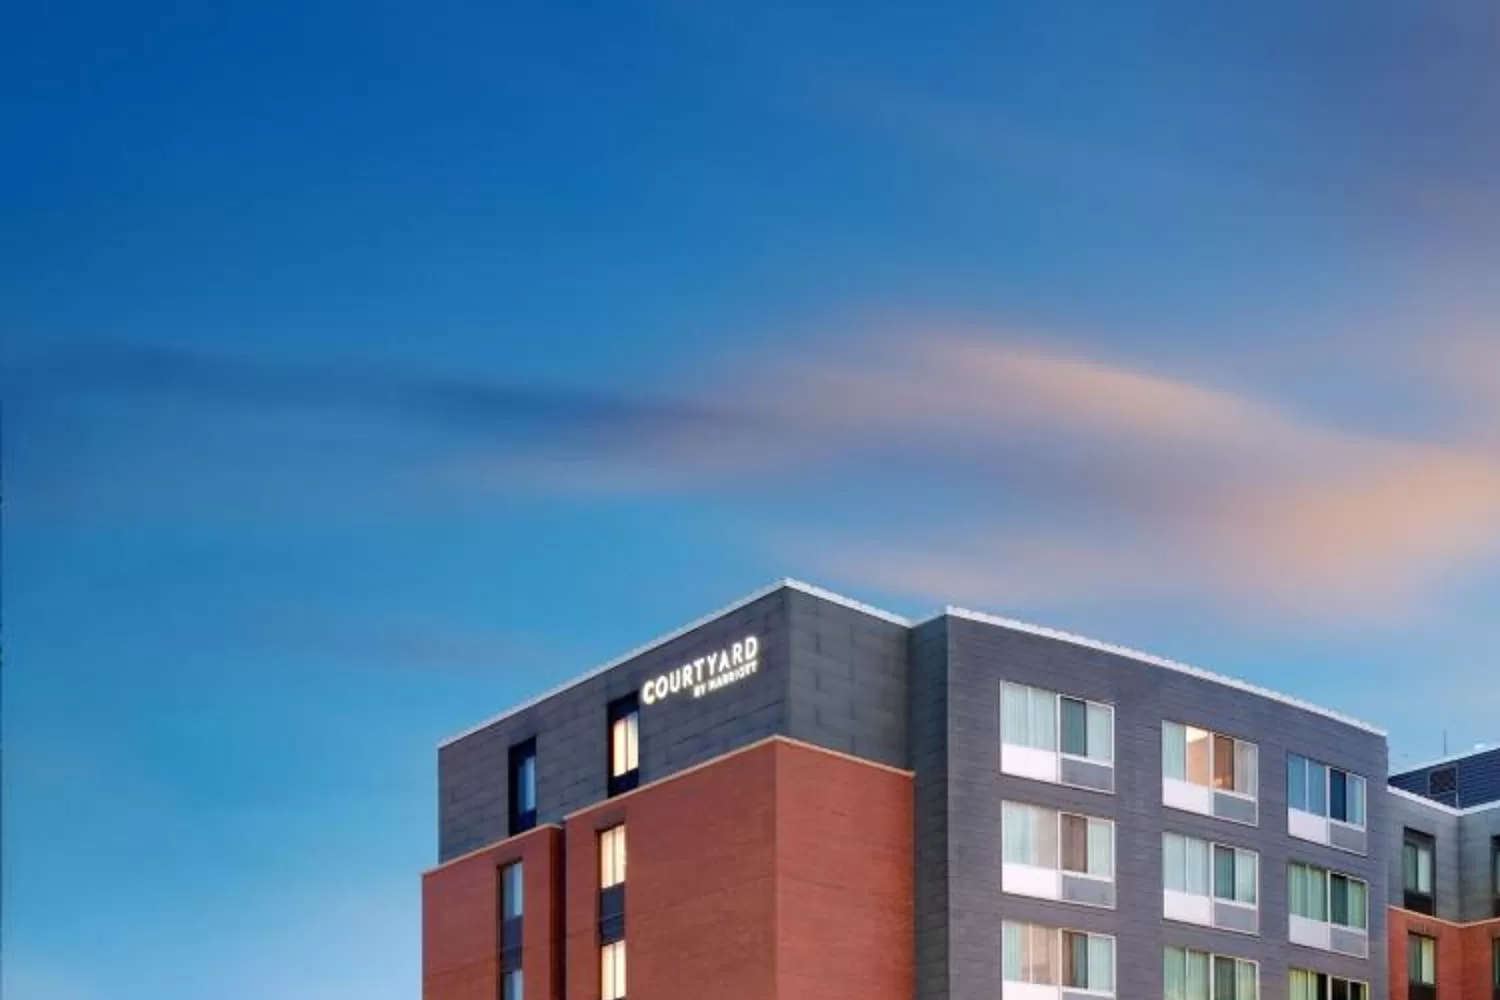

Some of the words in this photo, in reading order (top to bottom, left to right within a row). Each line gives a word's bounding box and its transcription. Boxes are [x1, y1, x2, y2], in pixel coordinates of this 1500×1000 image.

[641, 635, 758, 705] COURTYARD
[693, 683, 706, 698] BY
[708, 660, 758, 691] MARRIOTT
